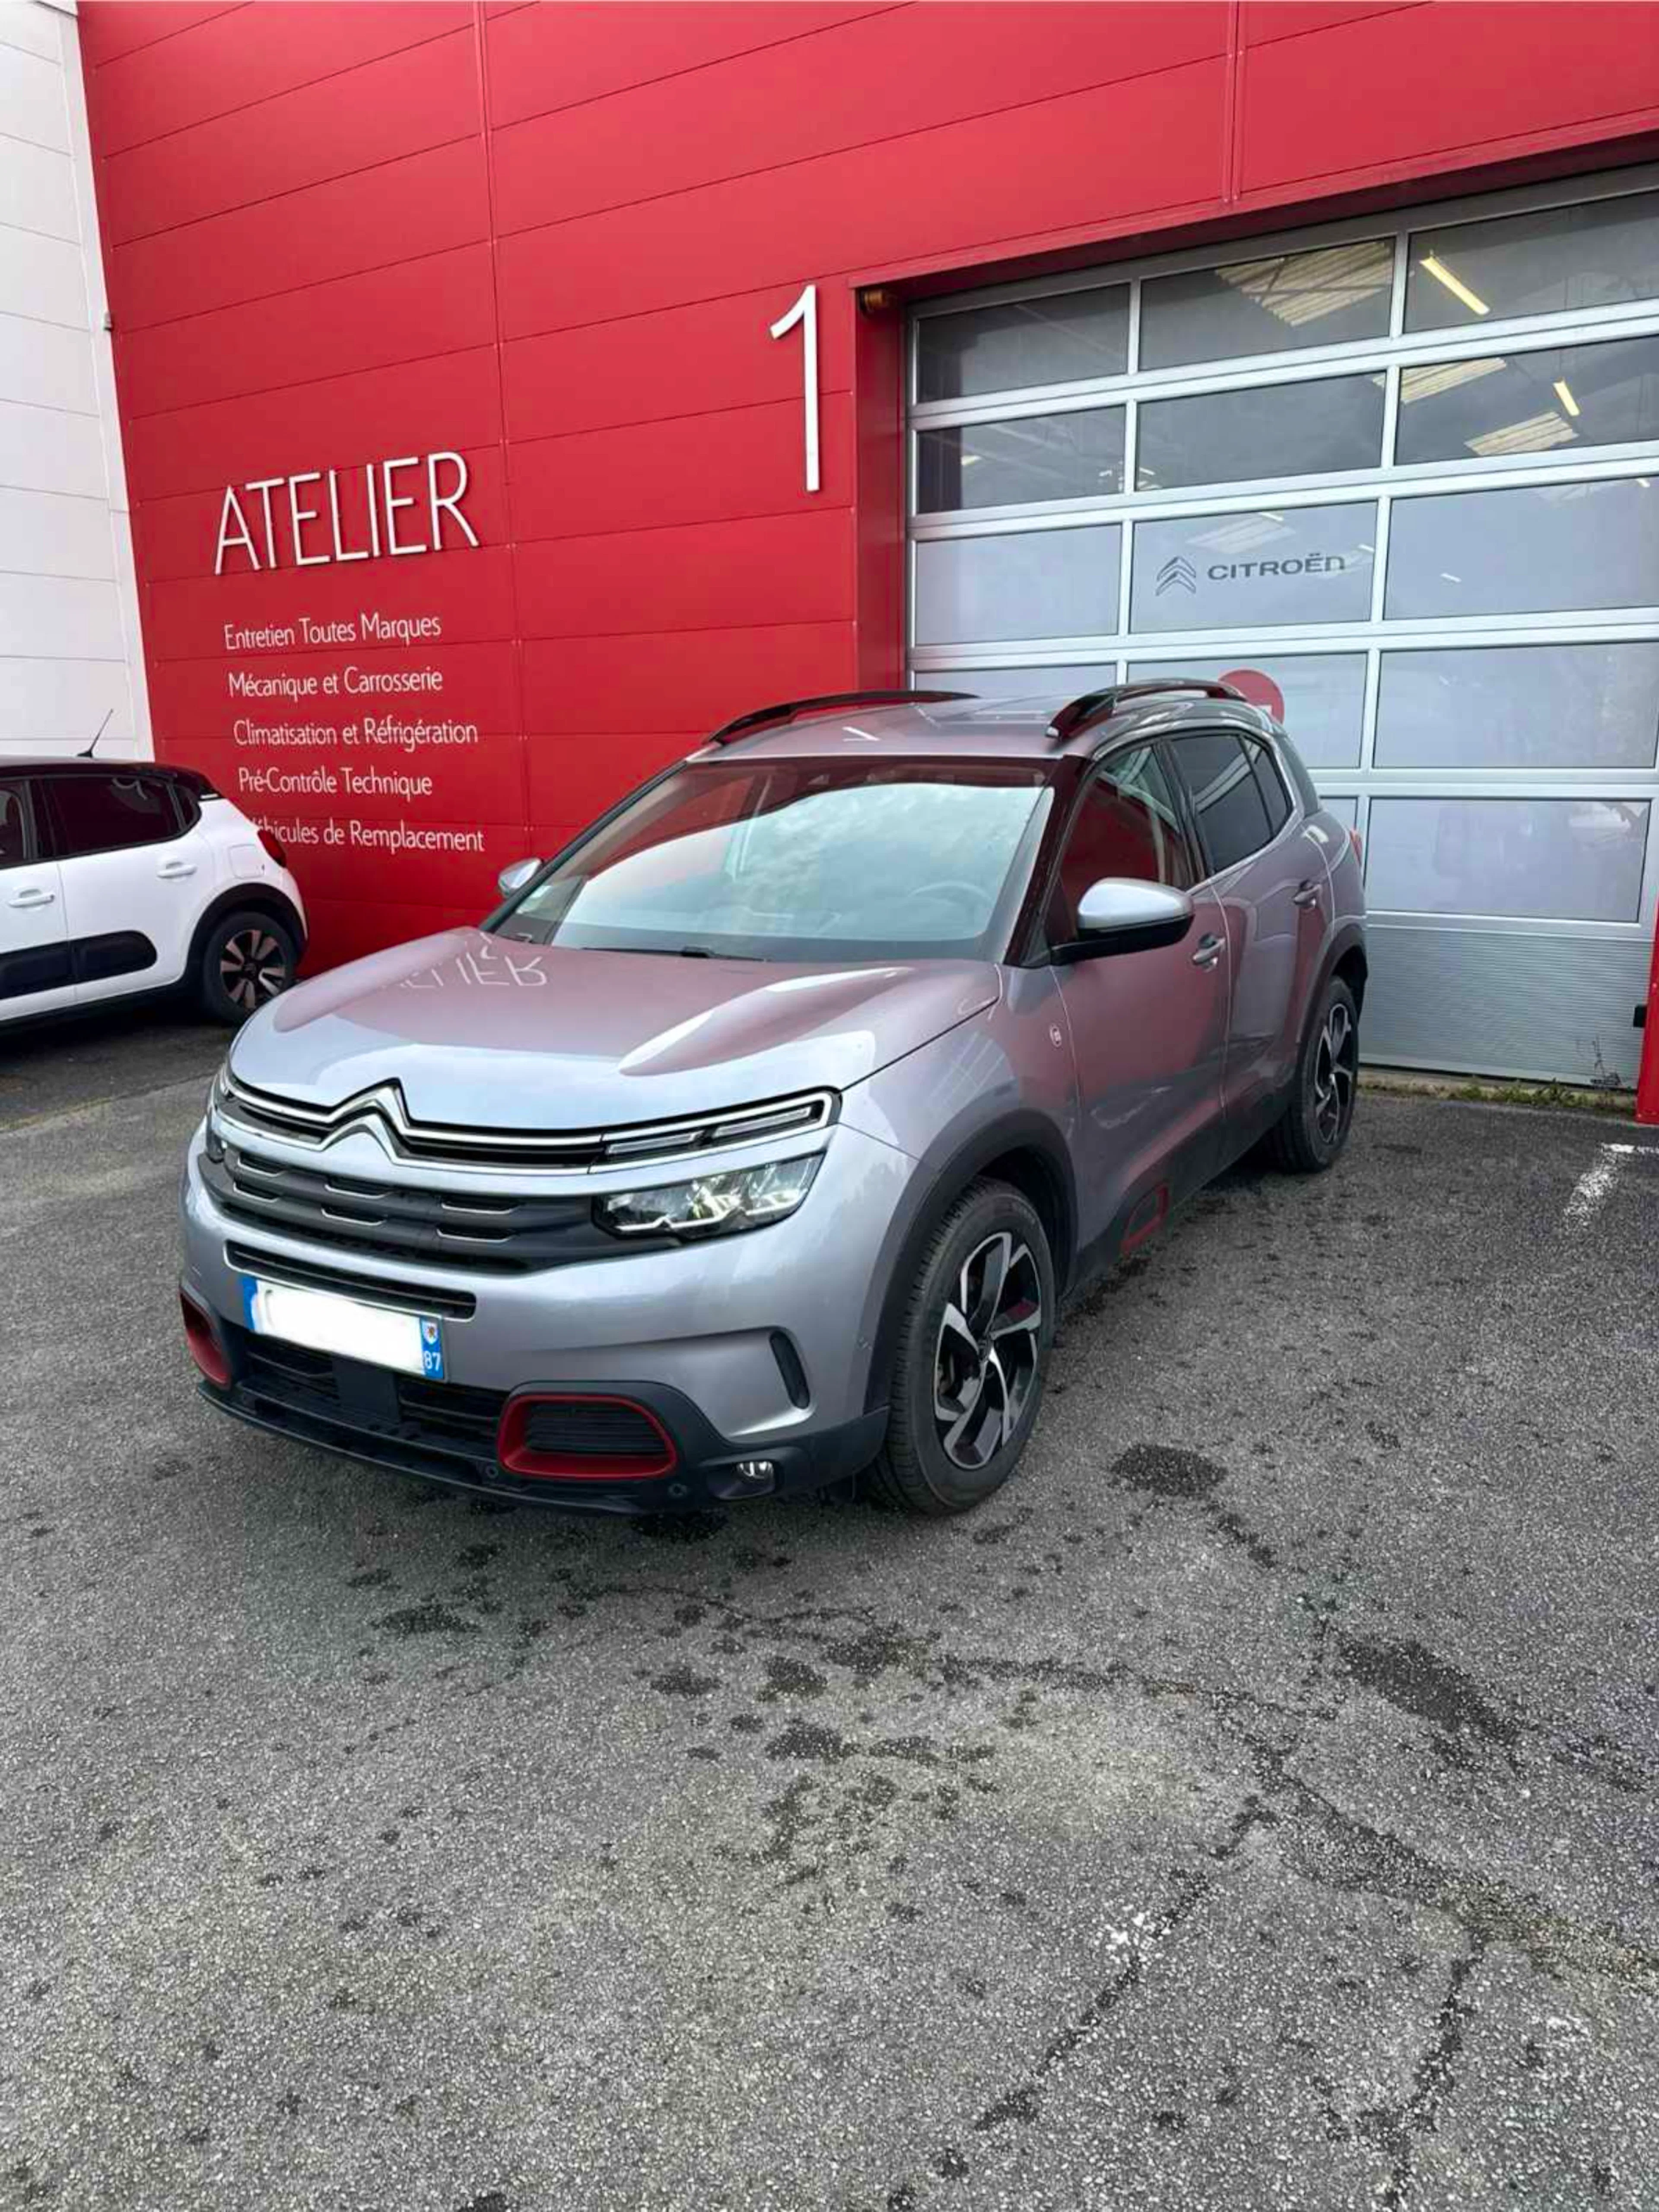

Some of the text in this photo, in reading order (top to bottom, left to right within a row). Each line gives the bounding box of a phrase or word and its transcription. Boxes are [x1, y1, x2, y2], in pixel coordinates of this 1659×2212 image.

[770, 284, 819, 492] 1
[215, 451, 479, 575] ATELIER
[224, 611, 442, 650] Entretien Toutes Marques
[228, 666, 443, 703] Mécanique et Carrosserie
[233, 714, 478, 753] Climatisation et Réfrigération
[238, 765, 432, 802] Pré-Contrôle Technique
[252, 815, 485, 855] hicules de Remplacement
[423, 1350, 441, 1372] 87
